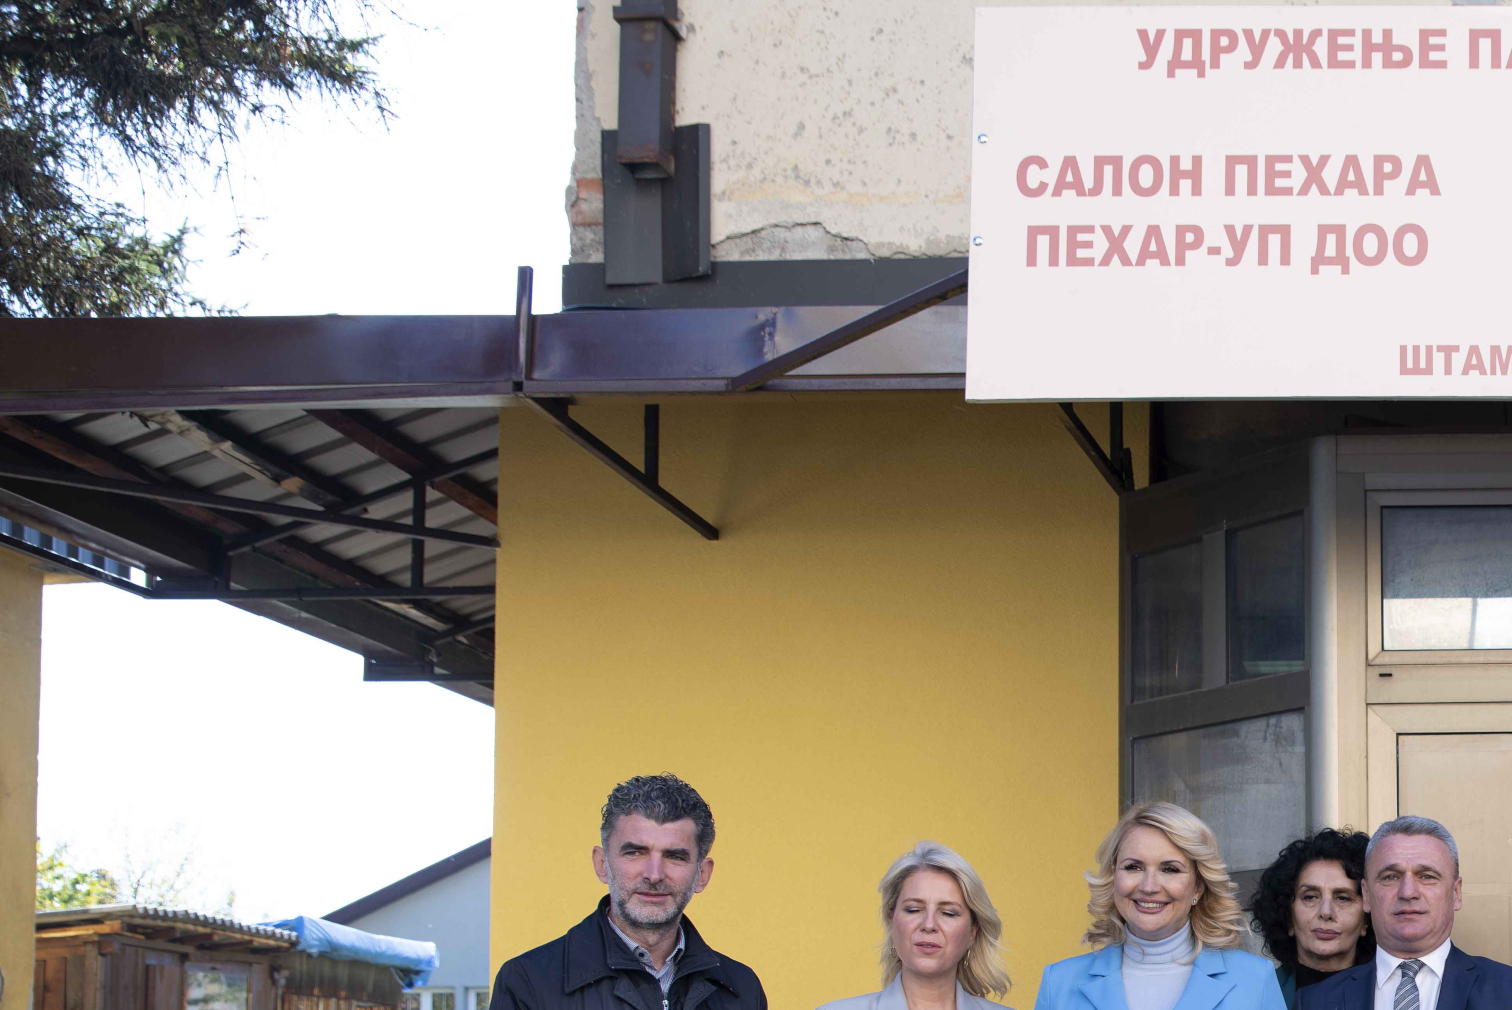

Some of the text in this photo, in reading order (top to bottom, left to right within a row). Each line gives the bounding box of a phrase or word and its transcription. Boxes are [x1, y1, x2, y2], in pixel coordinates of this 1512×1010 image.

[1137, 29, 1449, 78] УДРУЖЕЊЕ
[1016, 154, 1441, 198] САЛОН ПЕХАРА
[1026, 223, 1430, 275] ПЕХАР-УП ДОО
